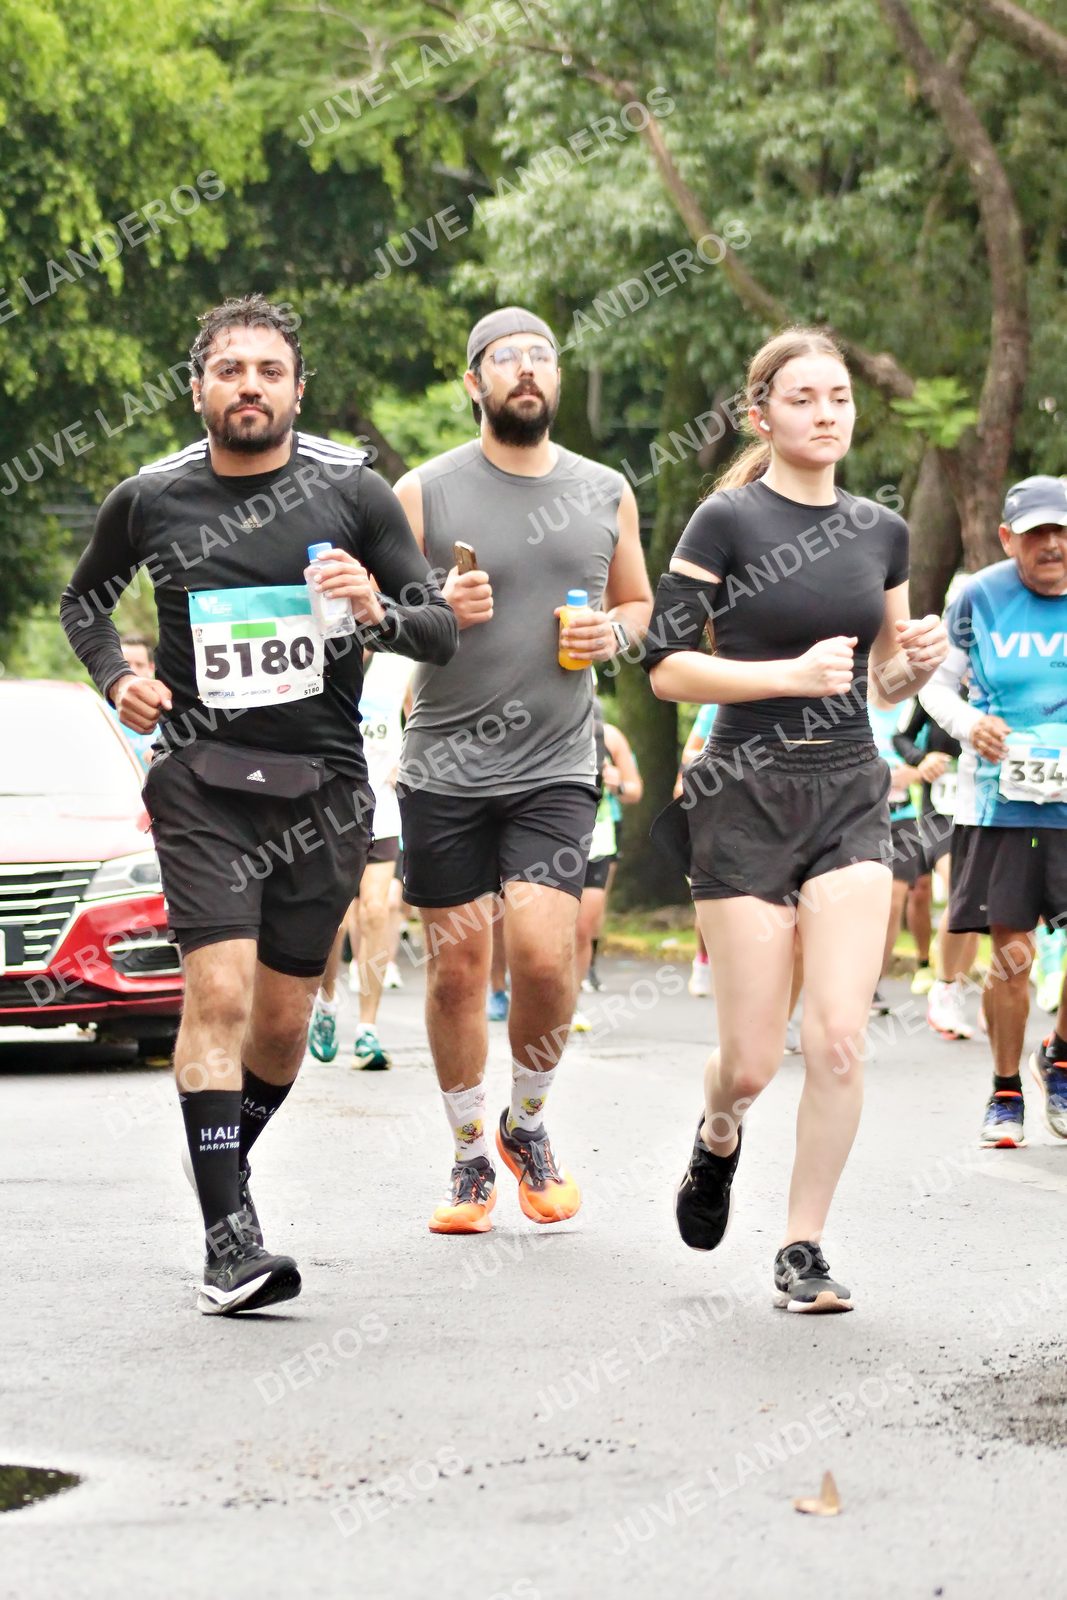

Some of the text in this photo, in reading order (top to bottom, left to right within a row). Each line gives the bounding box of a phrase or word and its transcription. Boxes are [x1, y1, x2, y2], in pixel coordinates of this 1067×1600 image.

[990, 632, 1067, 658] VIV
[204, 636, 315, 680] 5180
[304, 686, 320, 696] 5180
[1008, 760, 1067, 785] 334
[201, 1126, 240, 1141] HALF
